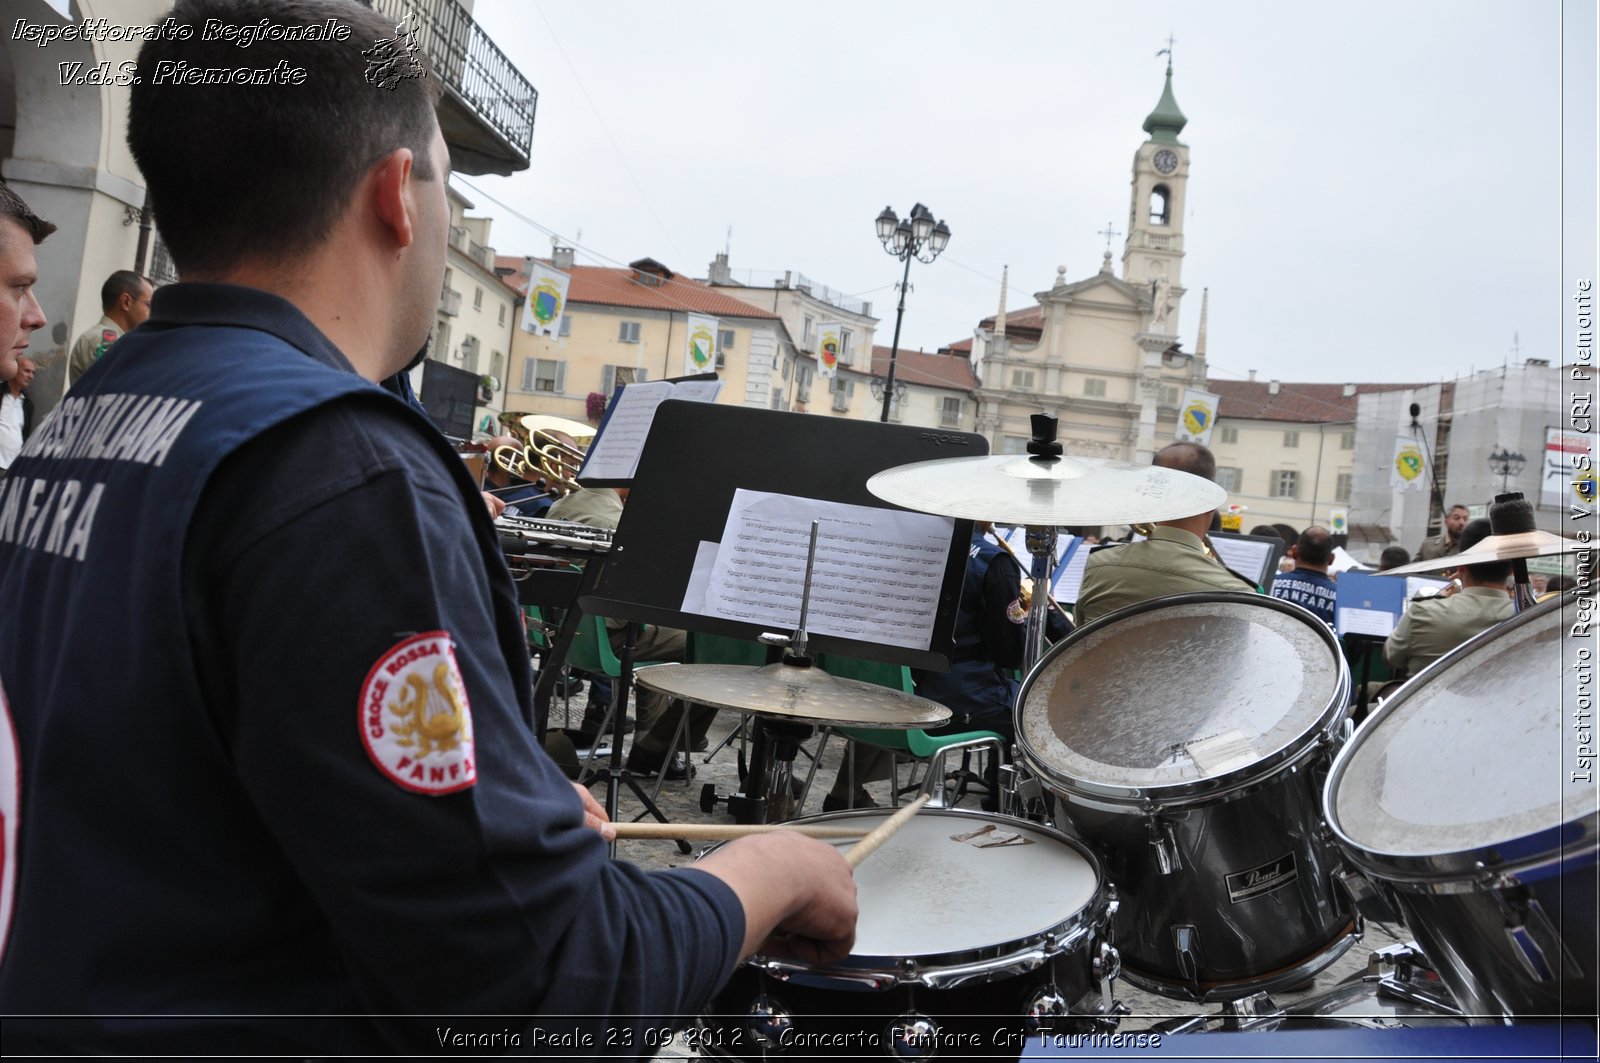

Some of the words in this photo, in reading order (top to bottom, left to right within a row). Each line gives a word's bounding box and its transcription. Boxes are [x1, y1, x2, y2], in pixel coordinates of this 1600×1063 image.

[70, 393, 203, 467] ITALIANA
[920, 431, 969, 446] PROEL
[0, 476, 106, 562] NFARA
[1274, 588, 1335, 612] FANFARA
[369, 679, 389, 739] CROCE
[386, 642, 441, 677] ROSSA
[1242, 863, 1281, 889] Pearl
